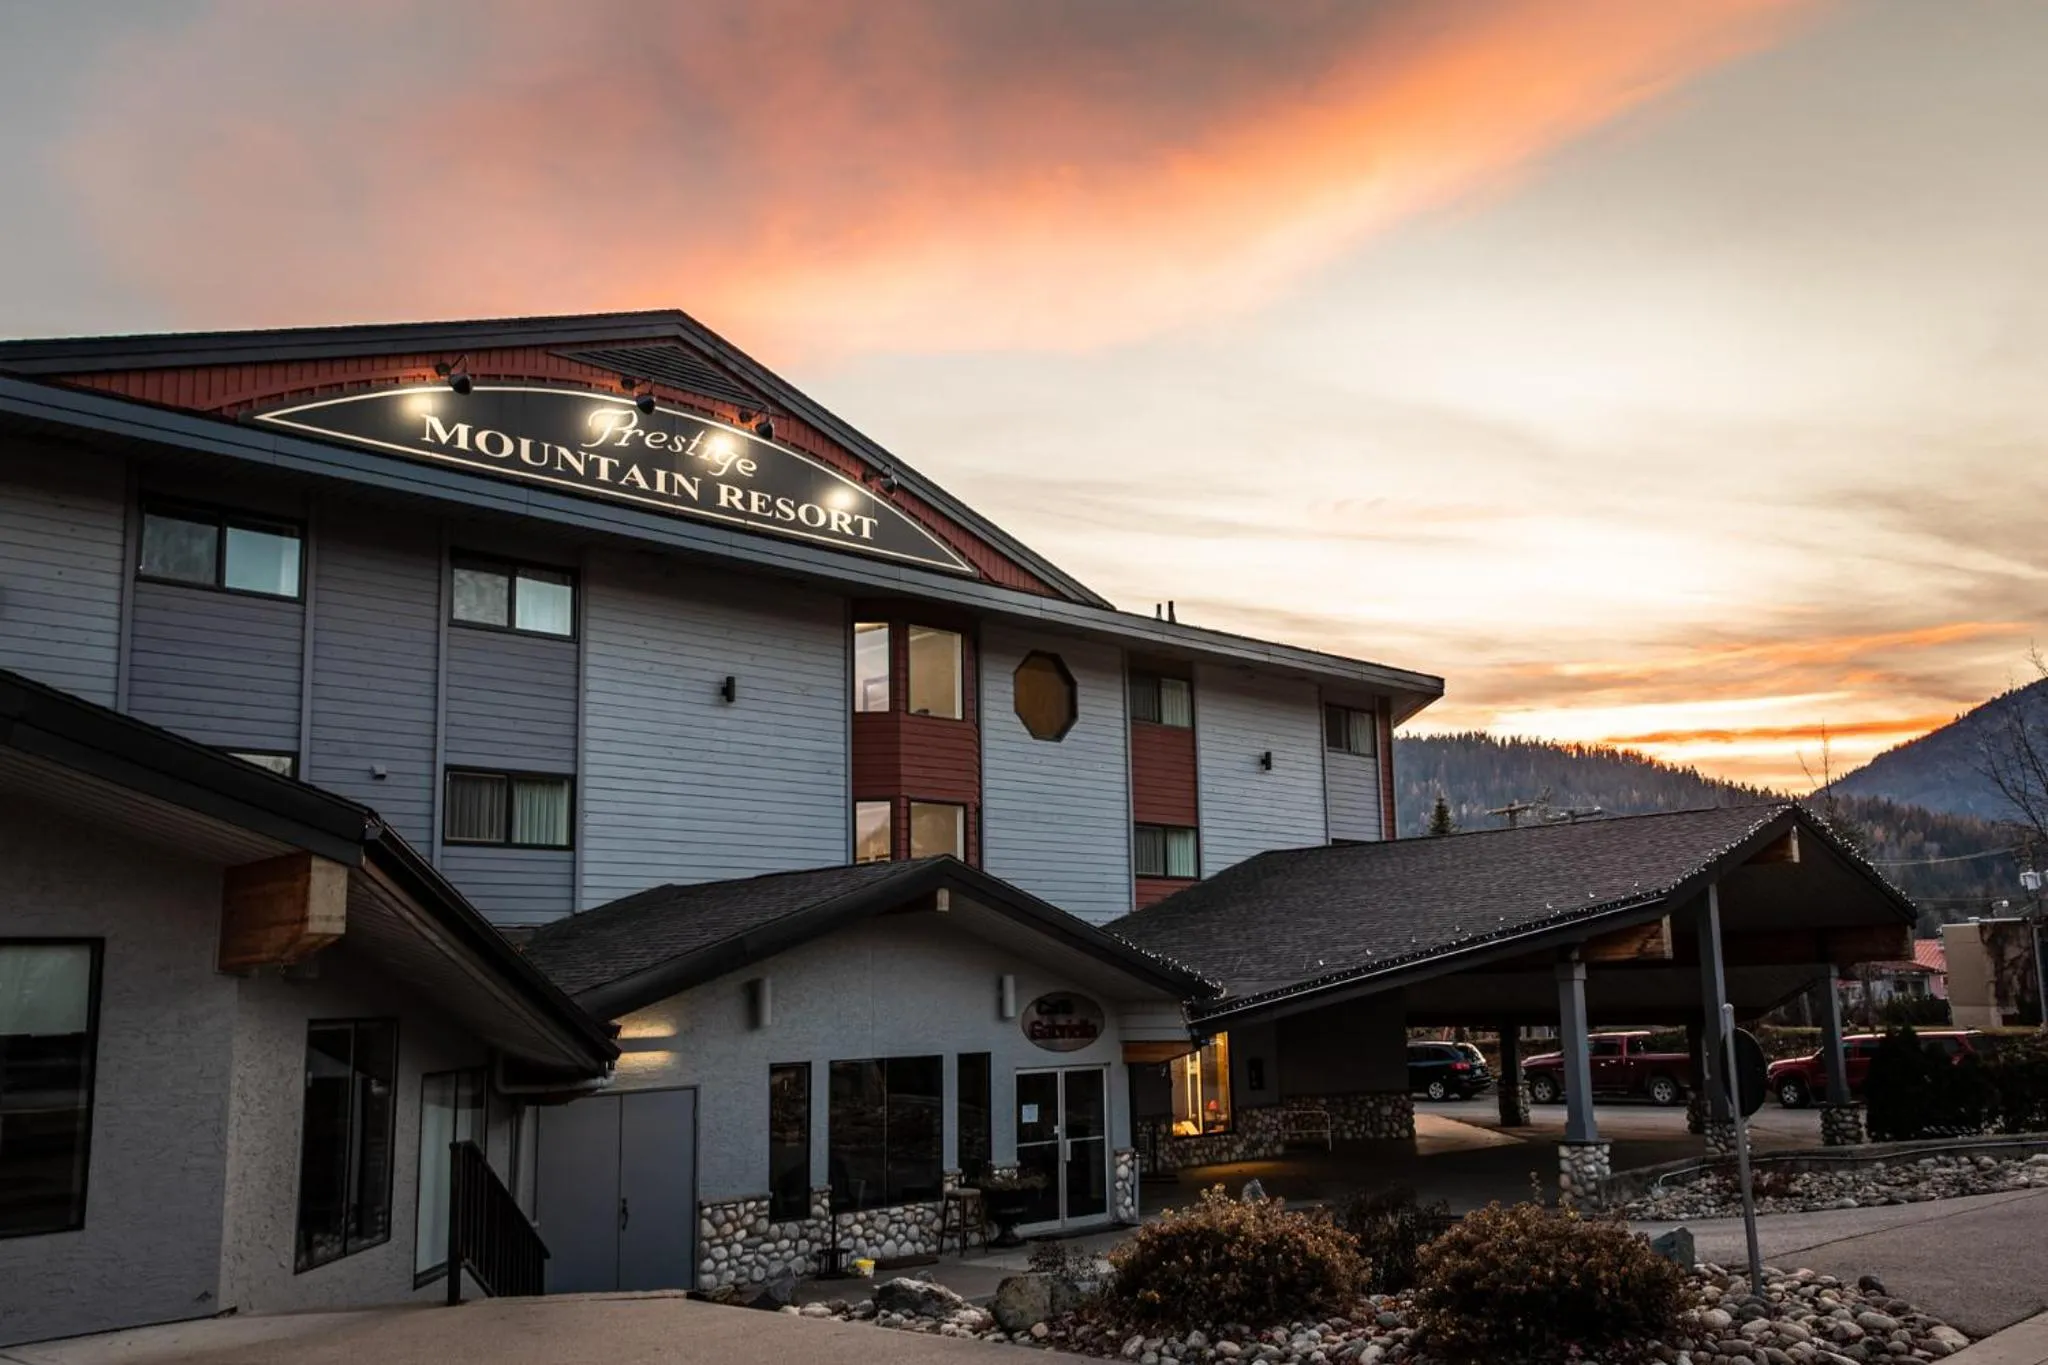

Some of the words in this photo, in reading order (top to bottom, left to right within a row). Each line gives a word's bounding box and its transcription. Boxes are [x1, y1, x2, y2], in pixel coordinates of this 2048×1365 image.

[421, 414, 700, 501] MOUNTAIN
[716, 483, 878, 540] RESORT
[581, 407, 758, 477] Prestige
